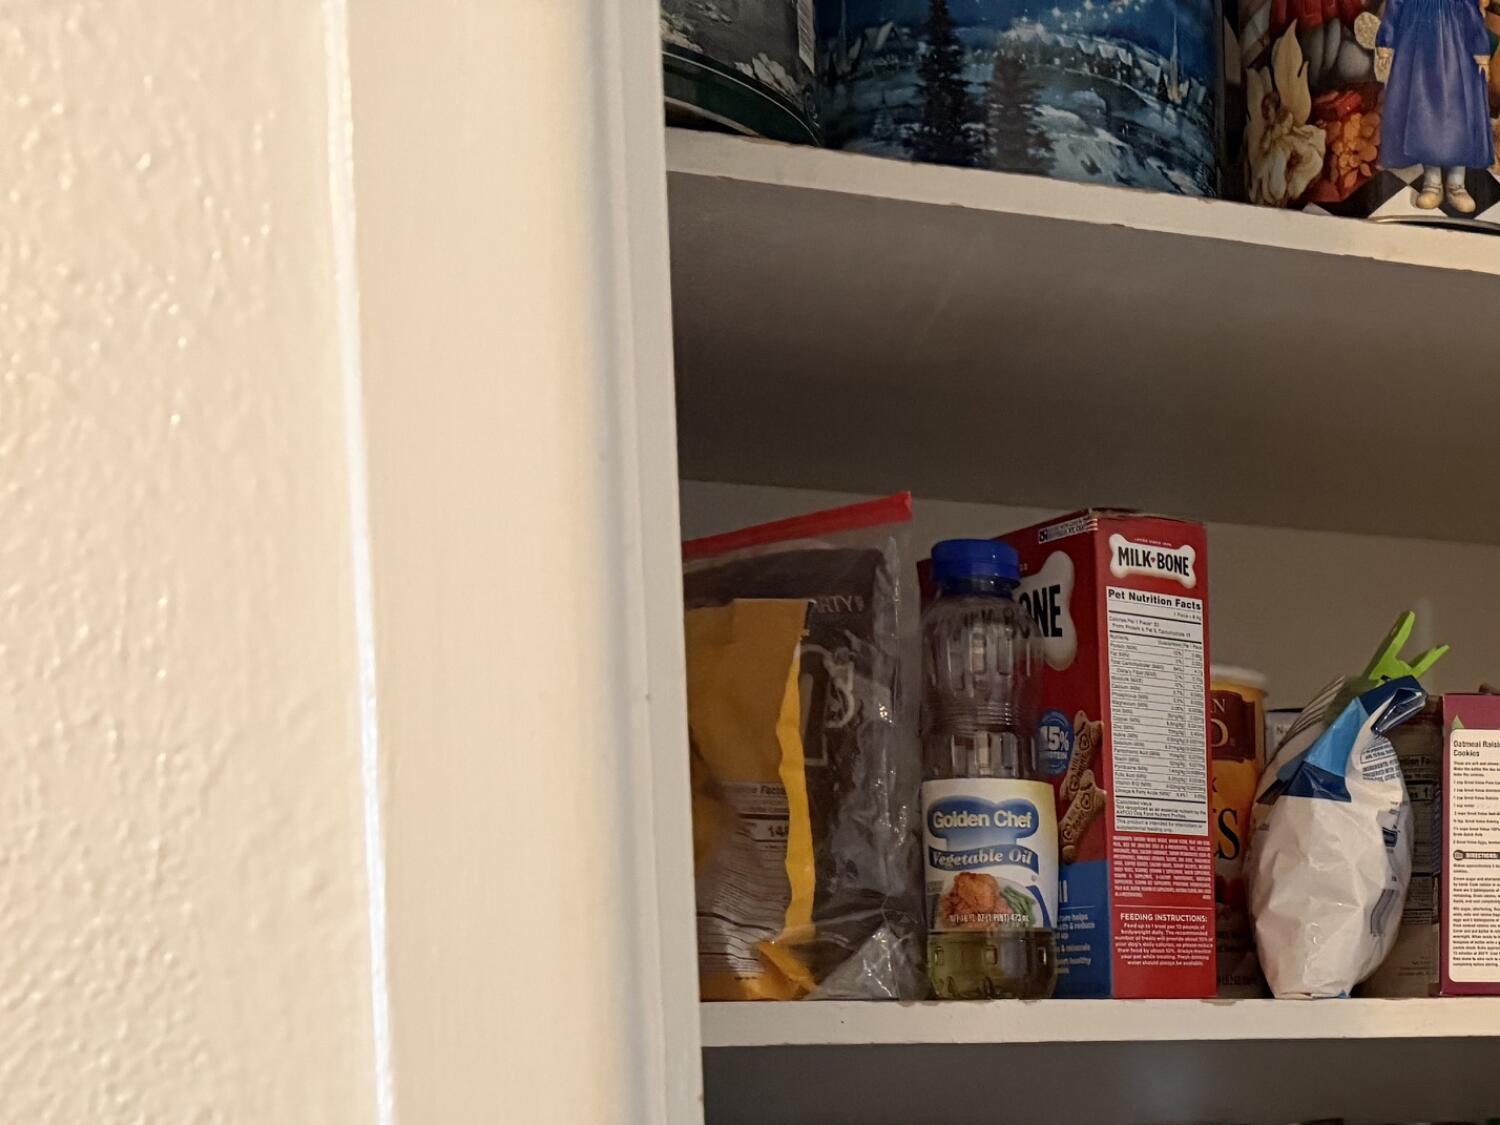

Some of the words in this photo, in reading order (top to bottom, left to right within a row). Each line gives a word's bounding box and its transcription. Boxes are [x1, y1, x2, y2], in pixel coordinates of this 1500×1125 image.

[1118, 546, 1151, 568] MILK
[1157, 552, 1190, 577] BONE
[1108, 588, 1125, 600] Pet
[1129, 592, 1172, 607] Nutrition
[1175, 598, 1202, 611] Facts
[1453, 740, 1481, 748] Oatmeal
[1453, 749, 1480, 757] Cookies
[932, 810, 990, 829] Golden
[994, 810, 1033, 829] Chef
[932, 847, 1003, 867] Vegetable
[1008, 849, 1033, 865] Oil
[1120, 913, 1153, 921] FEEDING
[1154, 913, 1208, 923] INSTRUCTIONS:
